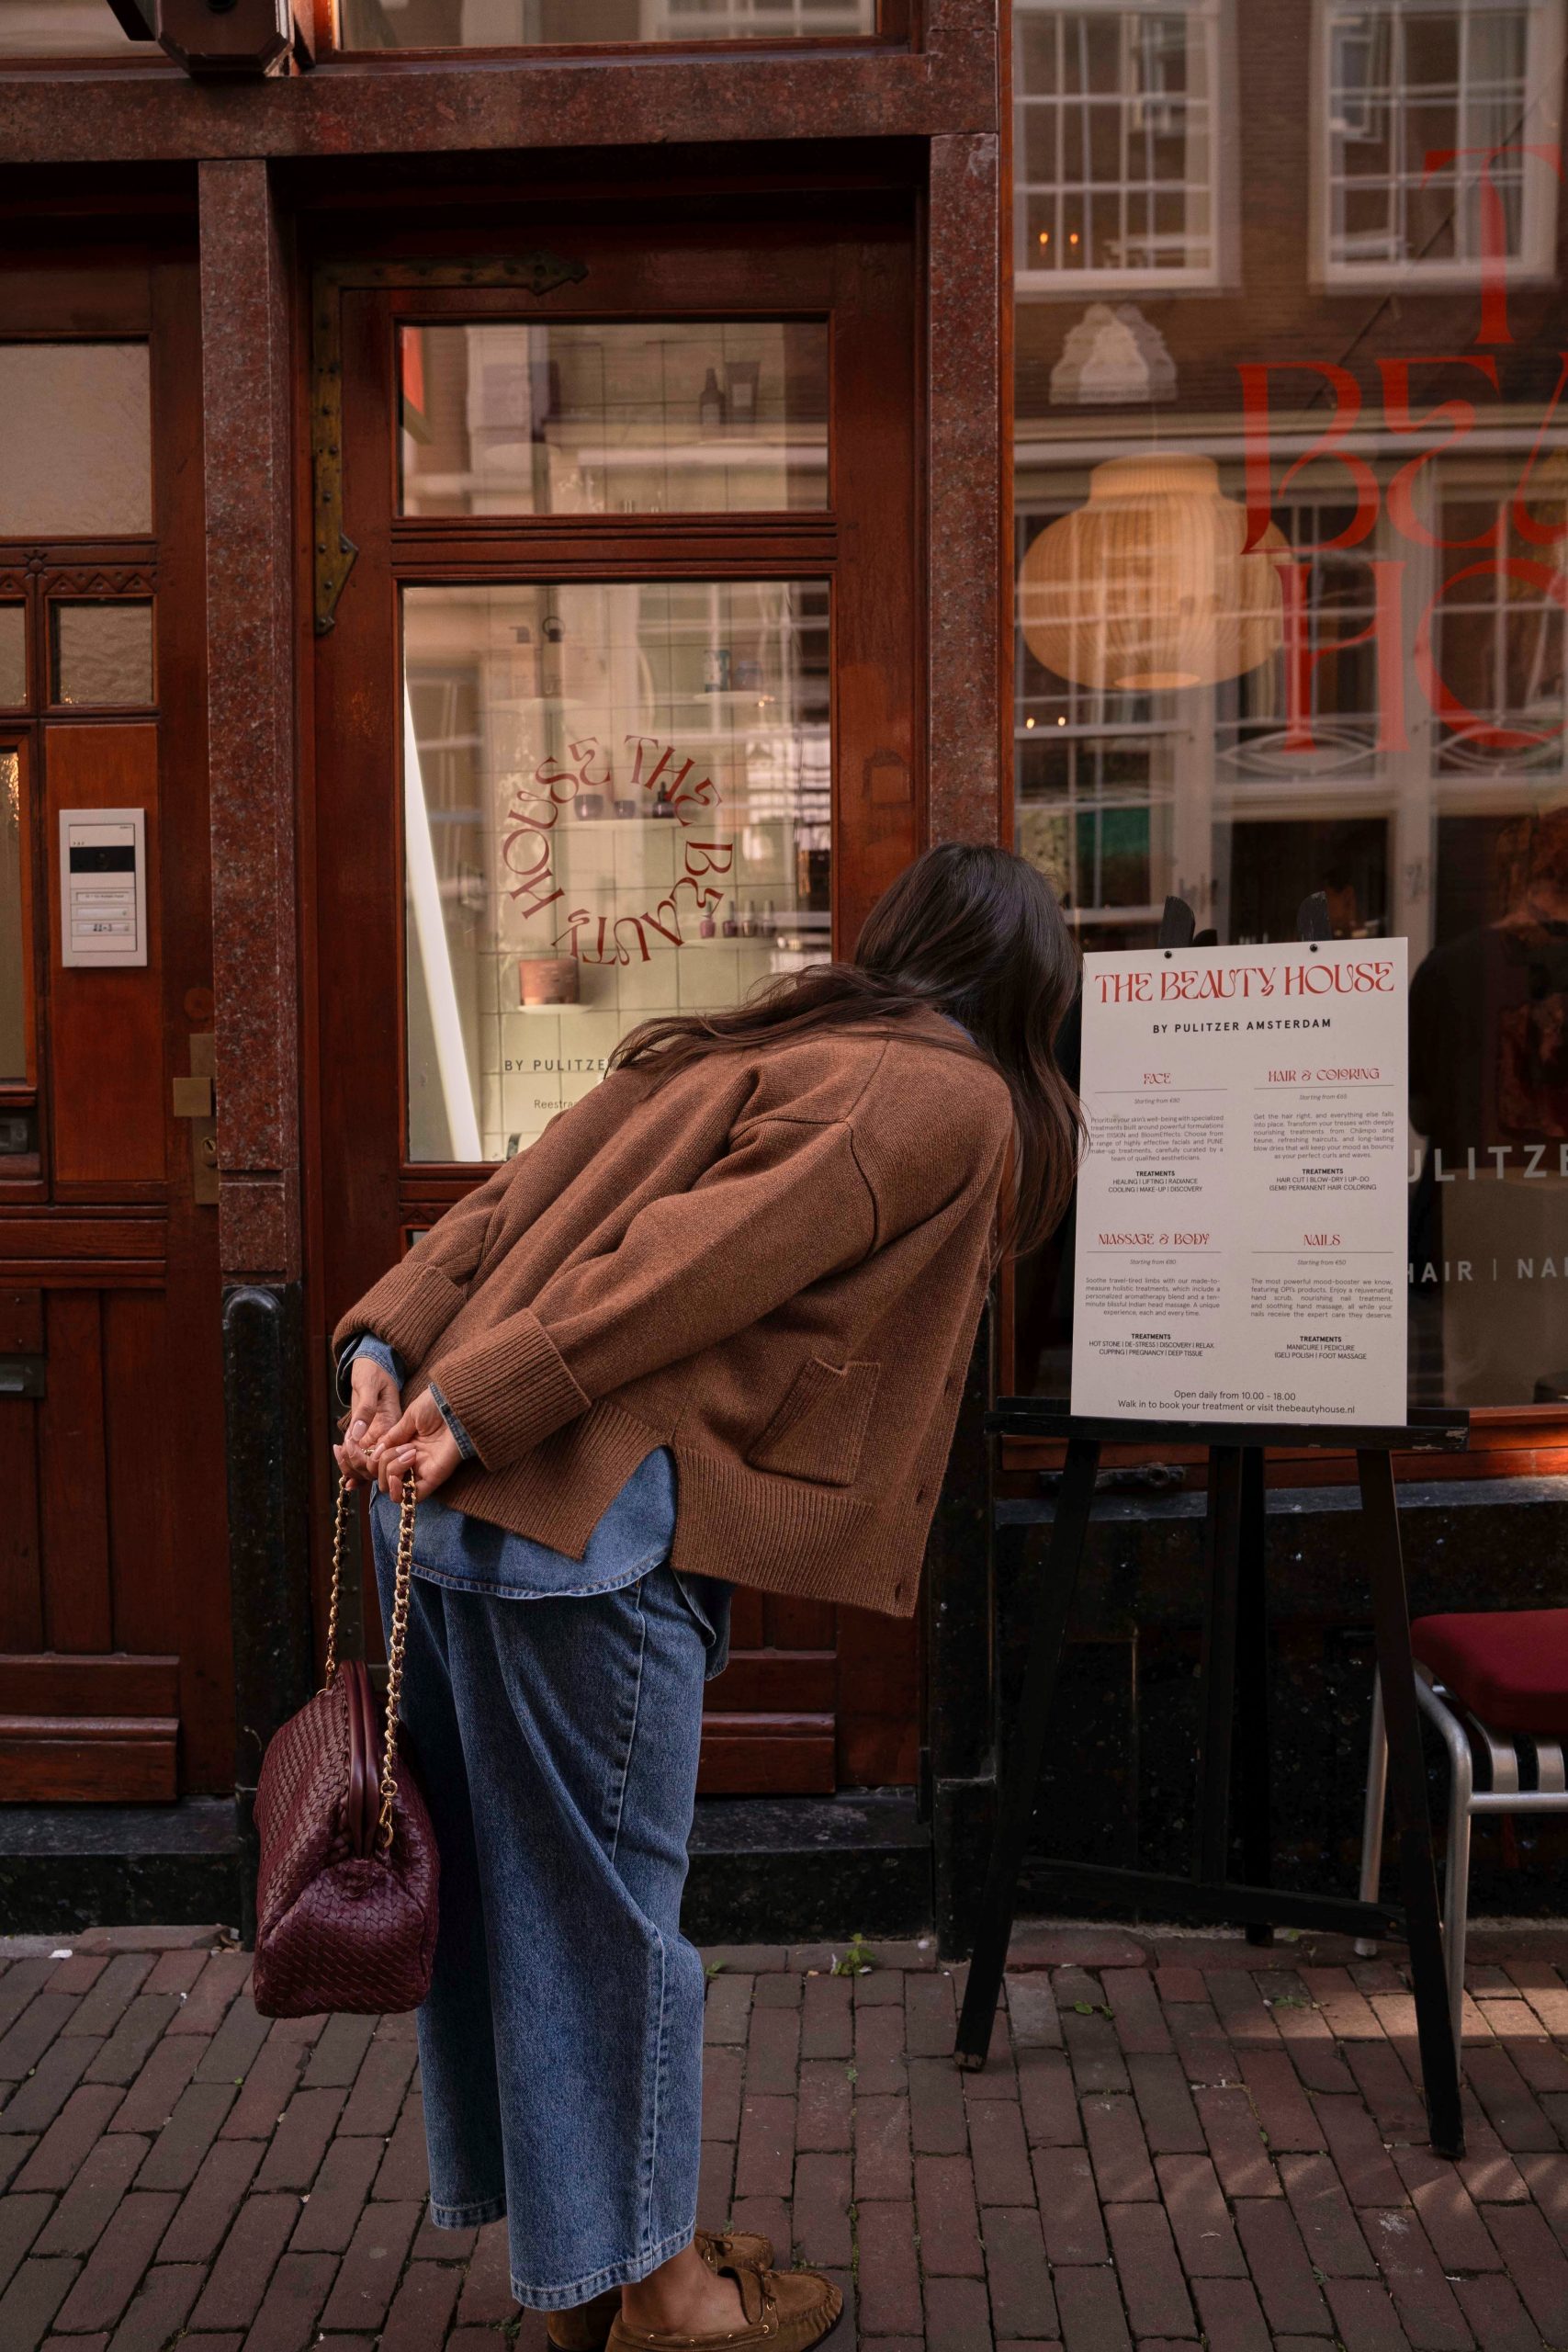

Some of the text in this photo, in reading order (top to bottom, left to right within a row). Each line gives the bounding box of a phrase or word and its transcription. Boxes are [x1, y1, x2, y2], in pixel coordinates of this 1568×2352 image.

[502, 735, 733, 966] THE BEAUTY HOUSE
[1095, 962, 1394, 1004] THE BEAUTY HOUSE
[1153, 1019, 1331, 1034] BY PULITZER AMSTERDAM
[505, 1059, 604, 1070] BY PULITZE
[1144, 1073, 1171, 1084] FACE
[1269, 1069, 1380, 1082] HAIR & COLORING
[1099, 1233, 1210, 1245] MASSAGE & BODY
[1303, 1235, 1340, 1246] NAILS
[1174, 1390, 1196, 1400] Open
[1199, 1391, 1217, 1400] daily
[1220, 1391, 1239, 1399] from
[1242, 1392, 1264, 1400] 10.00
[1273, 1393, 1296, 1401] 18.00
[1159, 1401, 1179, 1409] book
[1182, 1403, 1200, 1411] your
[1202, 1402, 1244, 1411] treatment
[1258, 1403, 1273, 1411] visit
[1276, 1404, 1355, 1415] thebeautyhouse.nl
